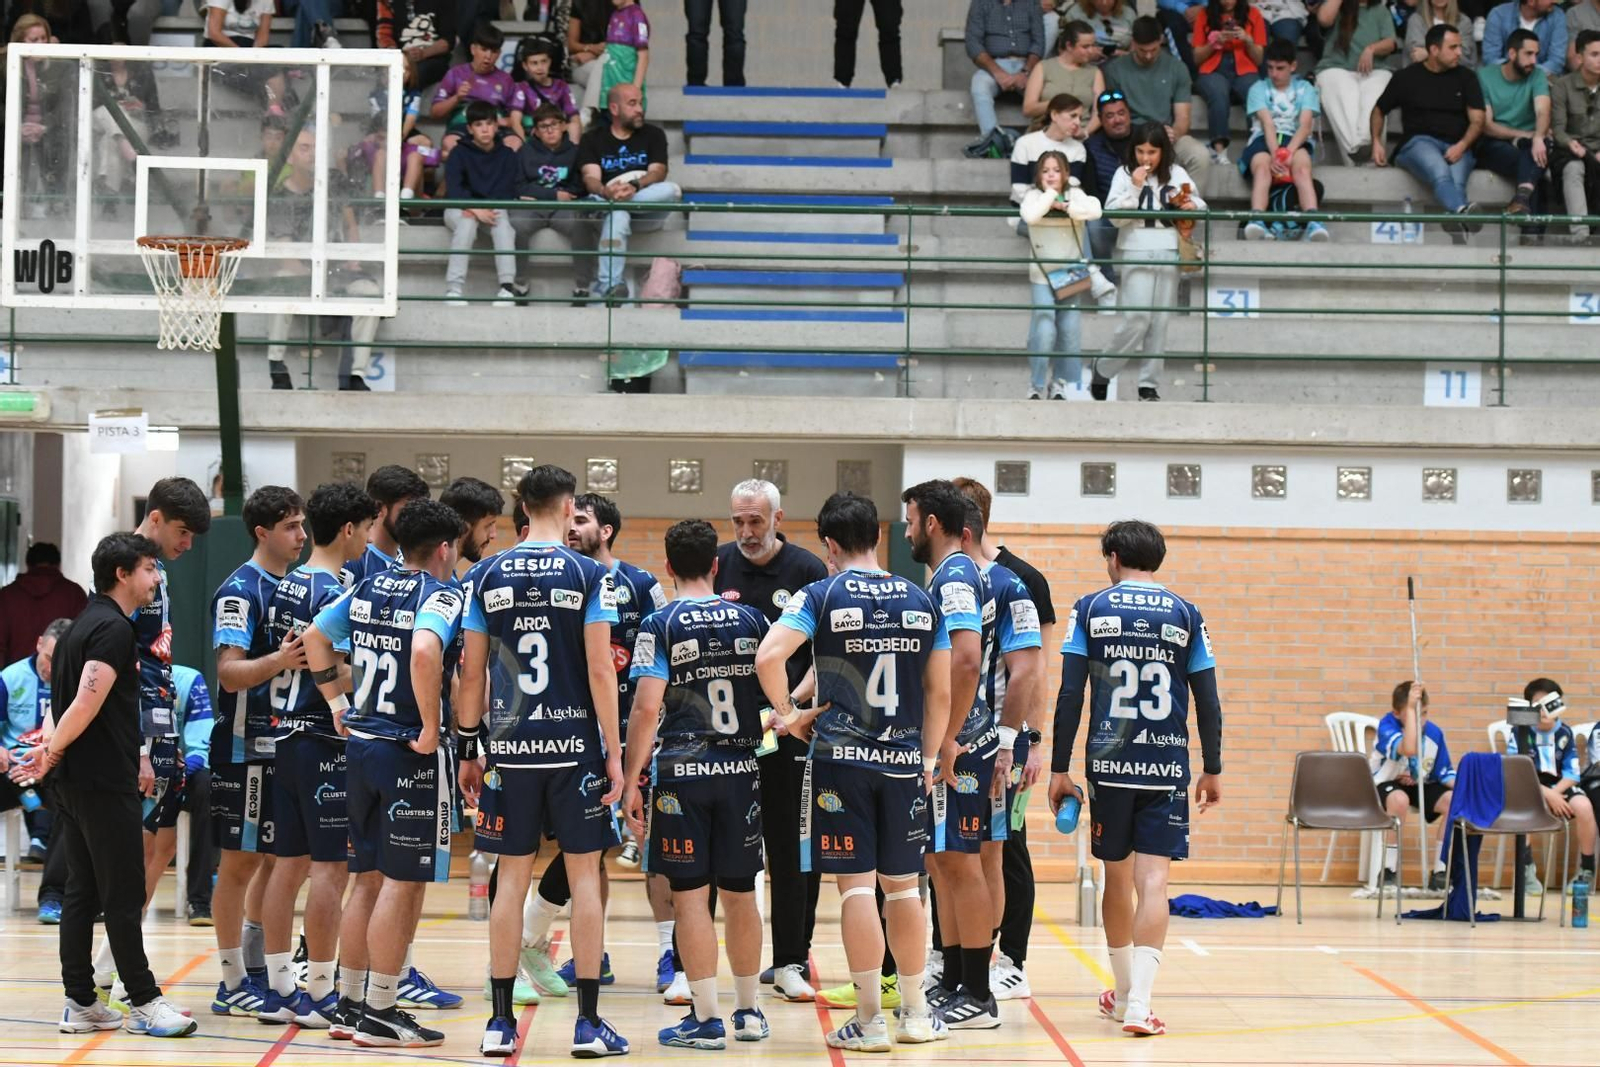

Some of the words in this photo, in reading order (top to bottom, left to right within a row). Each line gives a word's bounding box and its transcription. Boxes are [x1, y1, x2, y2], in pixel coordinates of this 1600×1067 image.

[1216, 290, 1249, 317] 31
[1440, 370, 1467, 399] 11
[97, 427, 129, 437] PISTA
[133, 427, 140, 436] 3
[501, 557, 566, 571] CESUR
[845, 580, 908, 595] CESUR
[488, 599, 511, 610] SAYCO
[1108, 592, 1174, 609] CESUR
[513, 616, 551, 631] ARCA
[678, 608, 740, 625] CESUR
[834, 619, 861, 629] SAYCO
[1093, 627, 1119, 635] SAYCO
[1122, 630, 1160, 640] HISPAMAROC
[353, 630, 402, 652] QUINTERO
[845, 637, 920, 653] ESCOBEDO
[672, 650, 697, 663] SAYCO
[1103, 644, 1143, 660] MANU
[1145, 643, 1175, 664] DÍAZ
[517, 632, 550, 696] 3
[353, 646, 399, 715] 72
[671, 671, 694, 687] J.A
[865, 653, 900, 717] 4
[1108, 659, 1173, 721] 23
[543, 706, 588, 722] Agebán
[707, 678, 740, 735] 8
[490, 735, 586, 755] BENAHAVÍS
[1147, 732, 1187, 748] Agebán
[832, 747, 921, 765] BENAHAVÍS
[320, 762, 335, 773] Mr
[1092, 761, 1184, 778] BENAHAVÍS
[396, 777, 414, 789] Mr
[413, 769, 435, 780] Jeff
